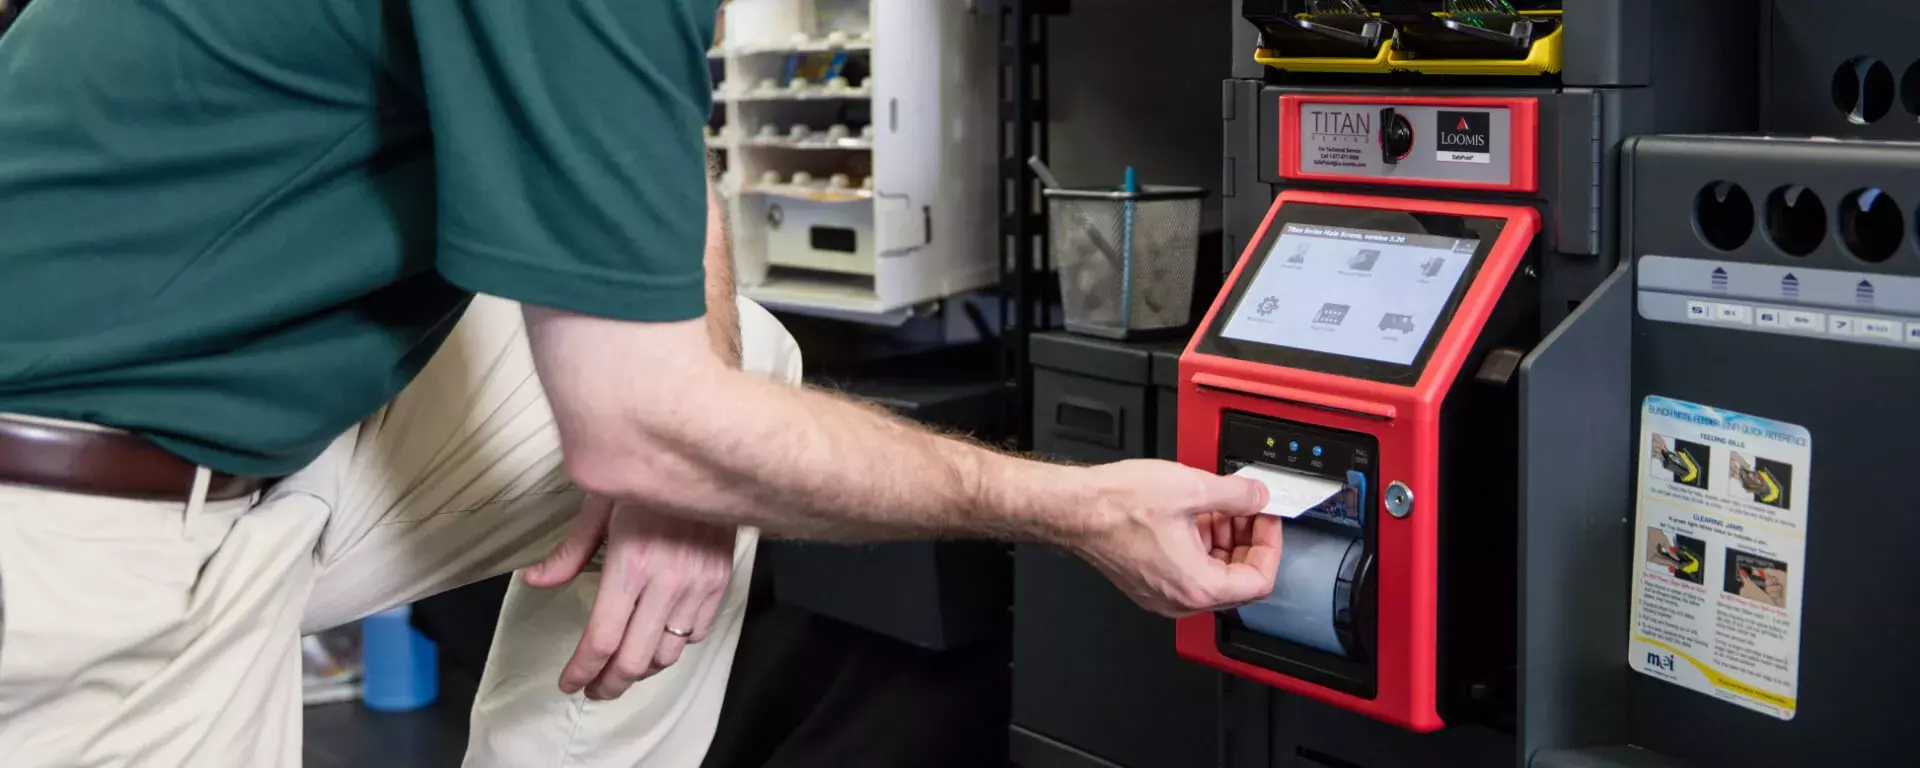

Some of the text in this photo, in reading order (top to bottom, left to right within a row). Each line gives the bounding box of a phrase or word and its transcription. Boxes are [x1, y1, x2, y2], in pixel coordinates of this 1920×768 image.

[1311, 111, 1370, 134] TITAN
[1441, 131, 1485, 146] LOOMIS
[1691, 306, 1703, 314] 5
[1836, 320, 1847, 329] 7
[1700, 433, 1726, 444] FEEDING
[1765, 430, 1807, 447] REFERENCE
[1693, 514, 1722, 526] CLEARING
[1647, 651, 1674, 671] mei
